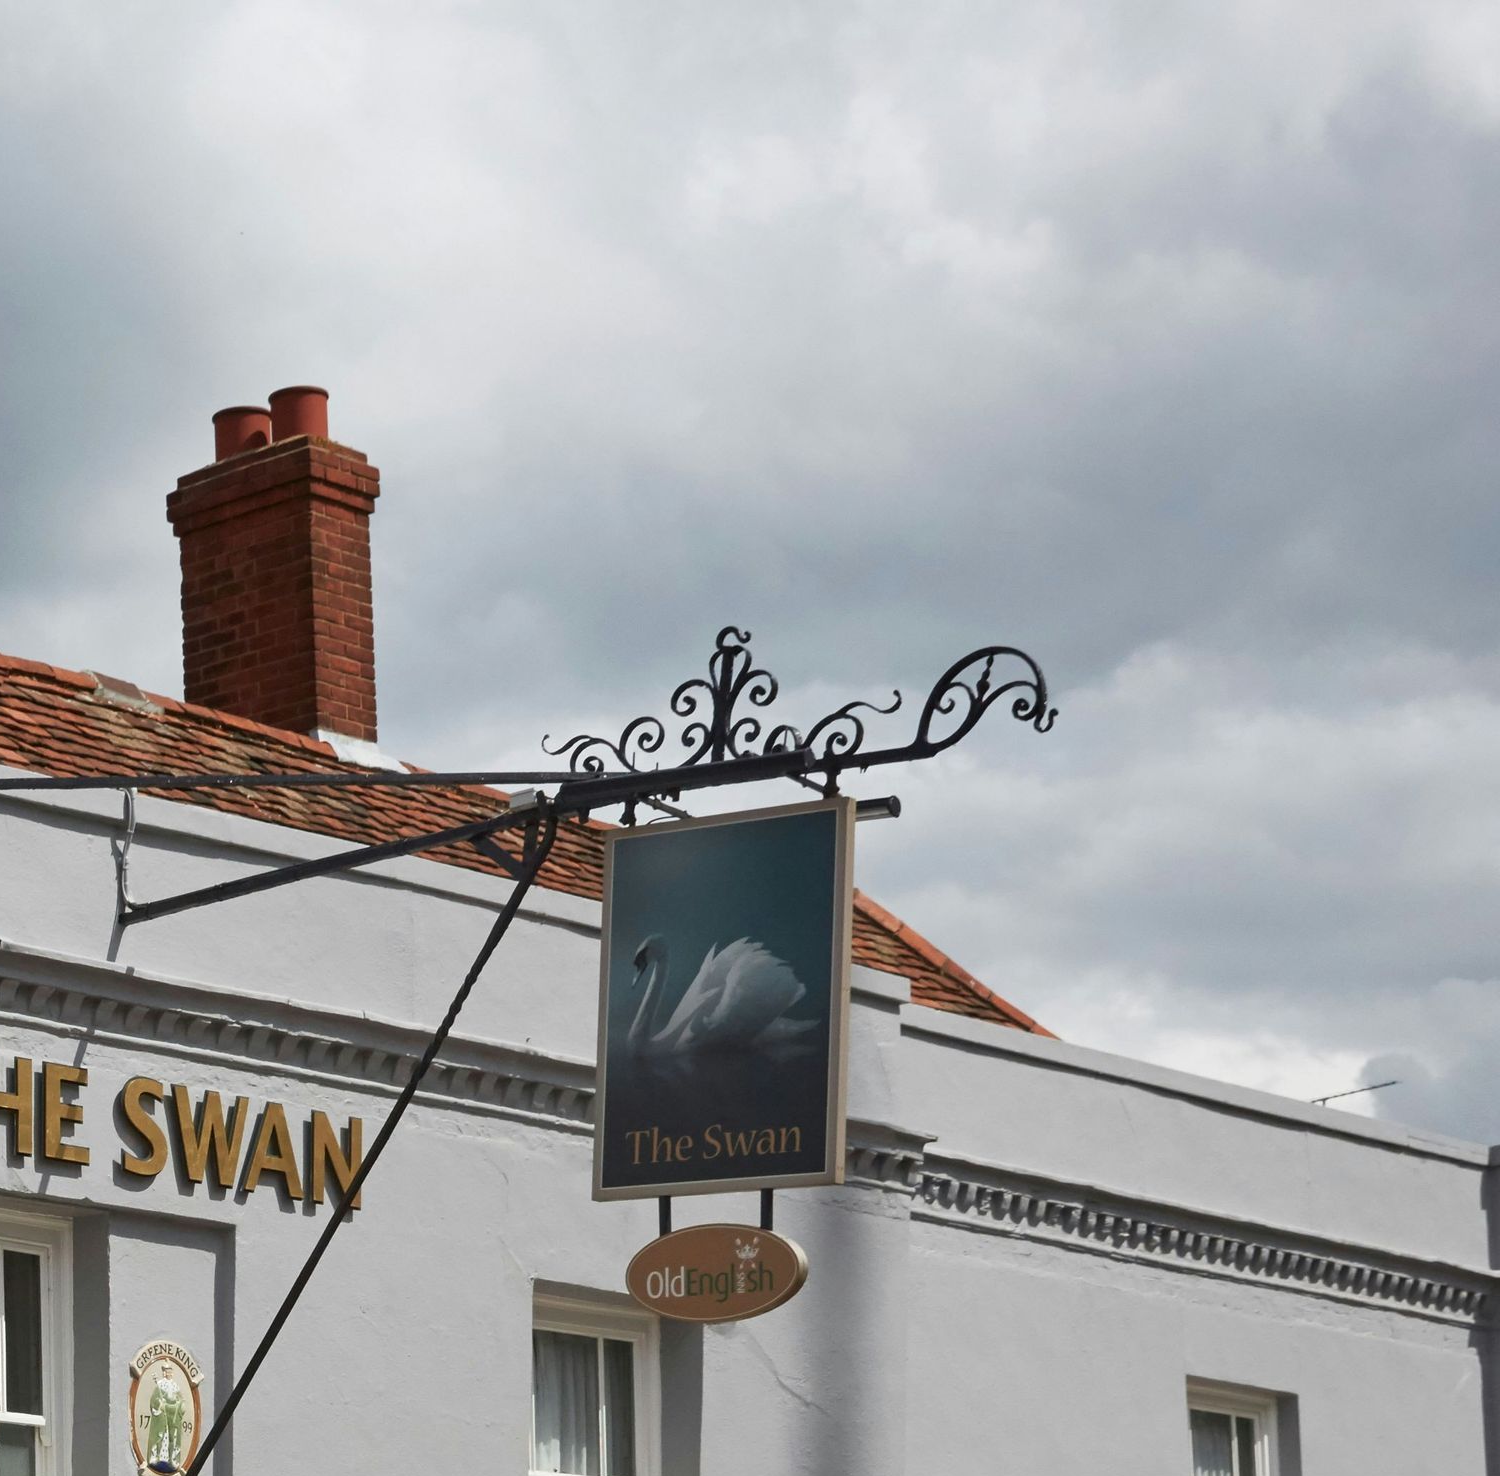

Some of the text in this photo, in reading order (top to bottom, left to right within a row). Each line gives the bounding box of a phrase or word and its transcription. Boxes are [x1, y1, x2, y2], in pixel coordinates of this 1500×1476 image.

[120, 1075, 362, 1211] SWAN
[625, 1124, 801, 1165] The Swan
[136, 1343, 199, 1379] GREENE KING
